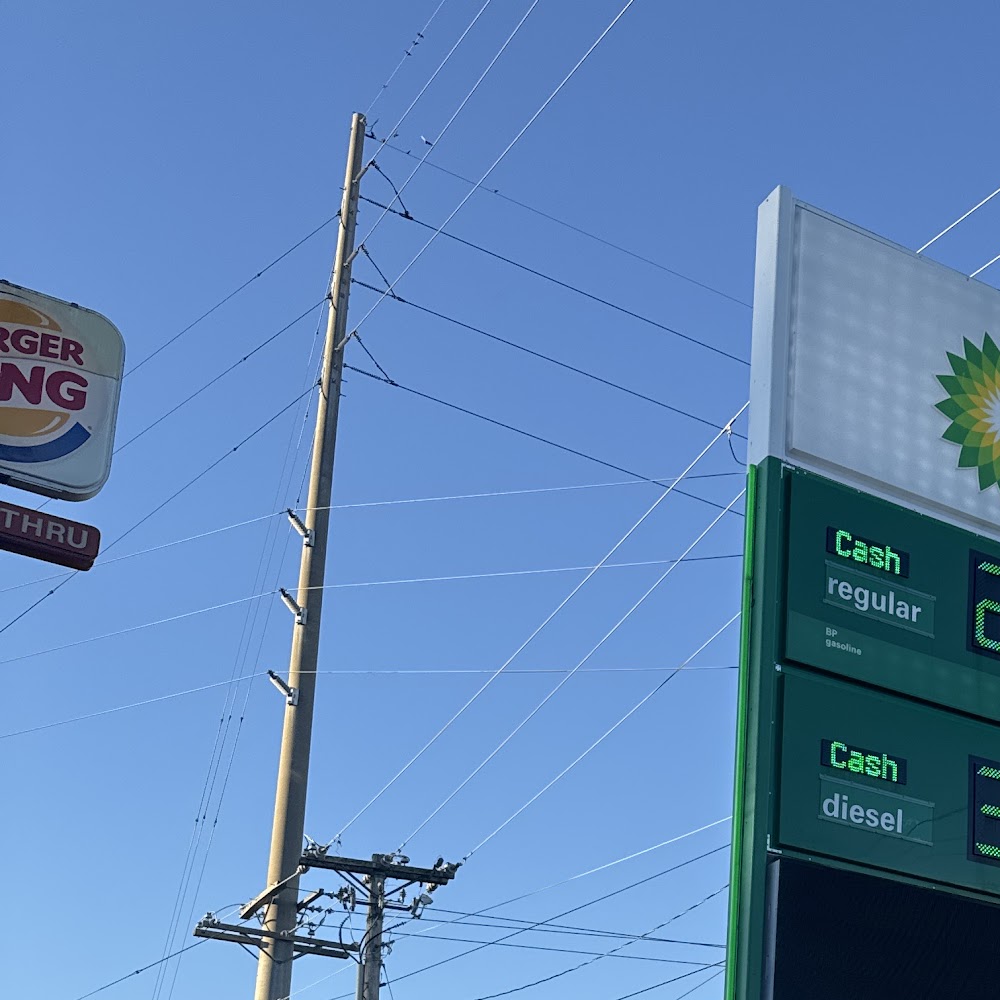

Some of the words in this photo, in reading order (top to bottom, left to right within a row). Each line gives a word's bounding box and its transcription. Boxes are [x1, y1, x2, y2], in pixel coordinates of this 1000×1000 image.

[0, 507, 88, 548] THRU
[835, 529, 901, 575] Cash
[828, 576, 922, 623] regular
[825, 627, 838, 637] BP
[825, 639, 862, 655] gasoline
[830, 741, 898, 782] Cash
[822, 793, 903, 833] diesel
